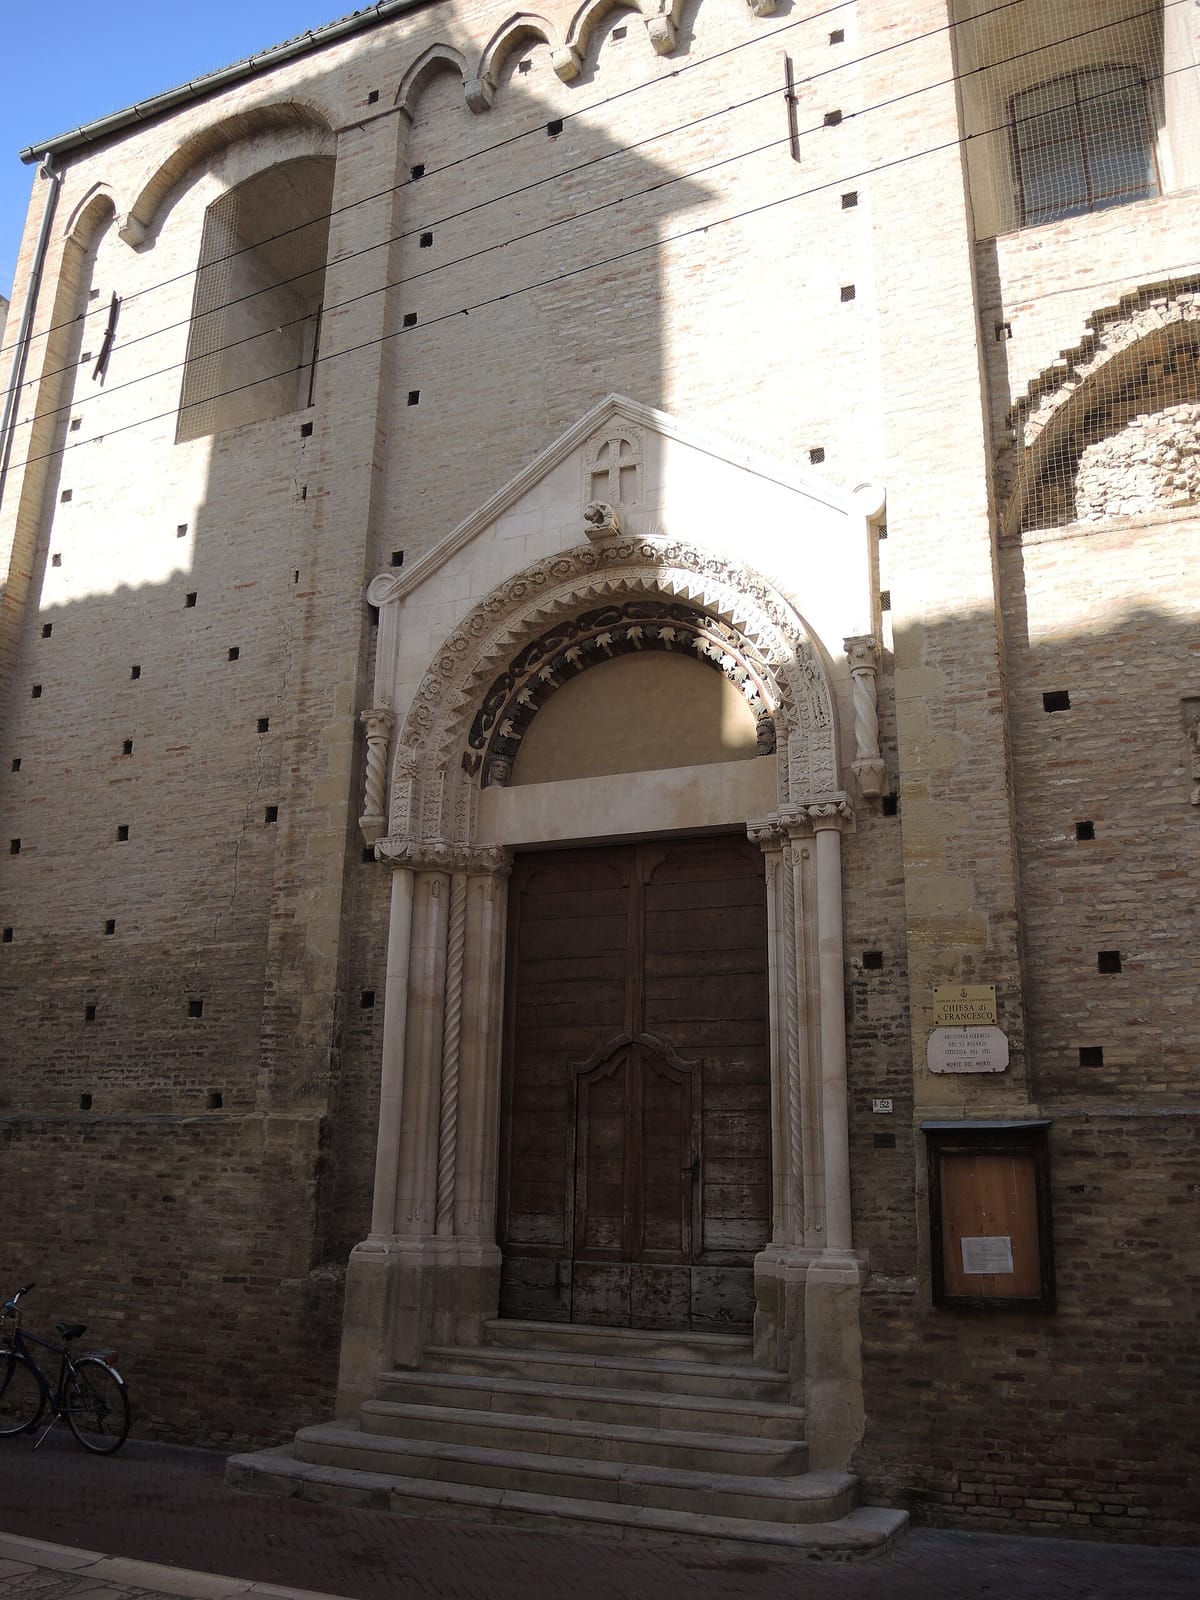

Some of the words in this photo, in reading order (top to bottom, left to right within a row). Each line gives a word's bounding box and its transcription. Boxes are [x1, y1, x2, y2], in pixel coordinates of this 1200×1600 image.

[943, 1004, 975, 1012] CHIESA
[979, 1003, 987, 1011] di
[879, 1100, 890, 1108] 52
